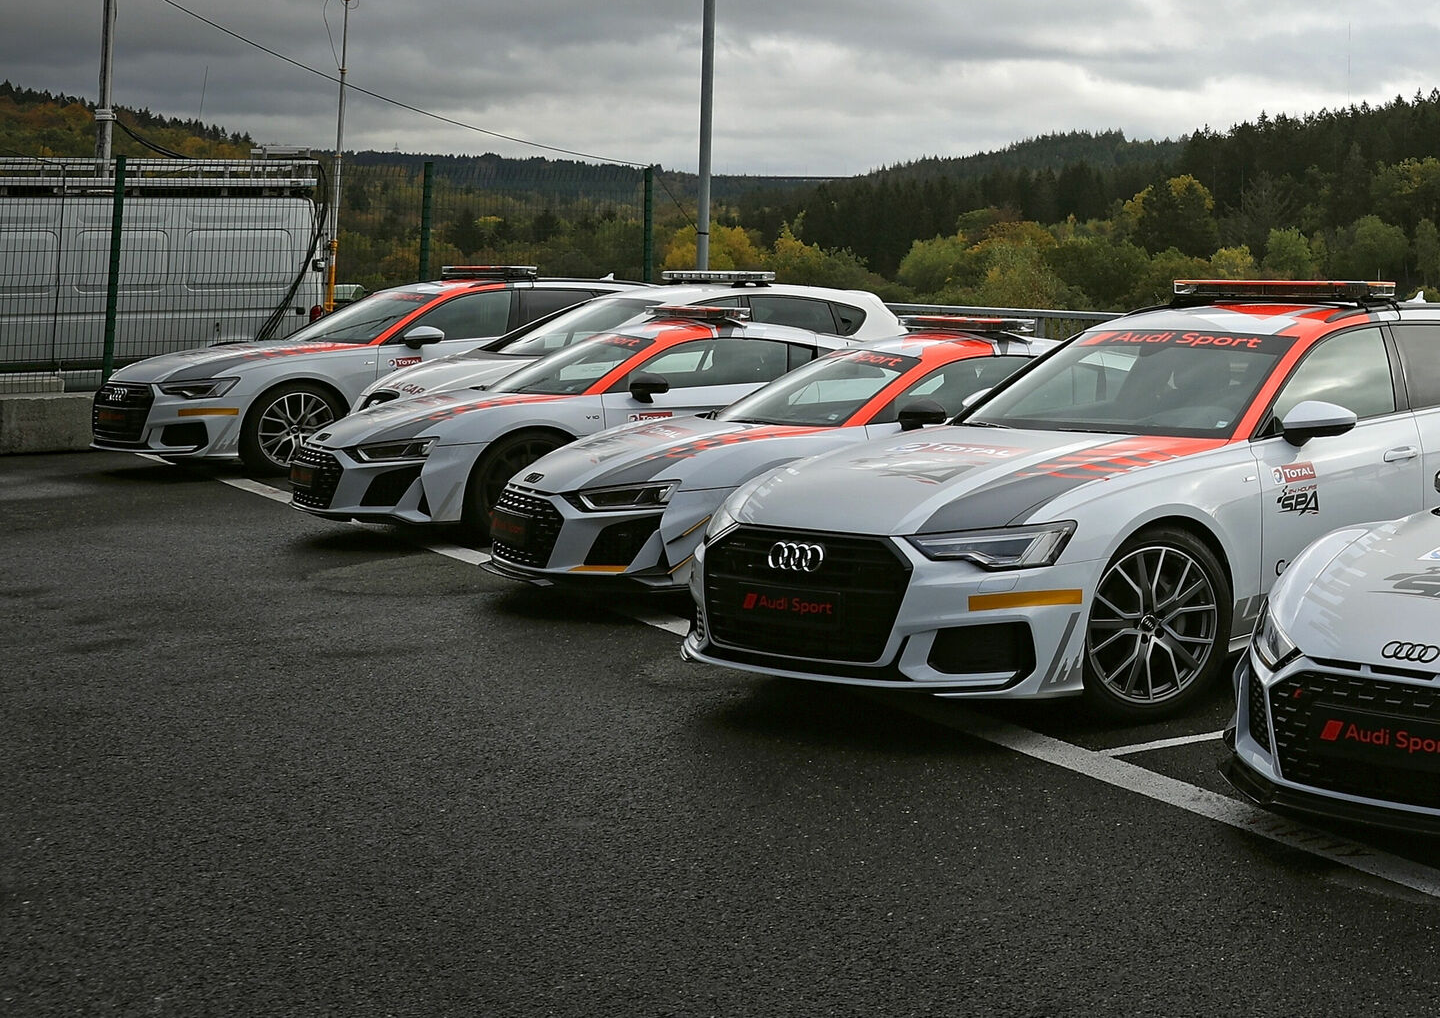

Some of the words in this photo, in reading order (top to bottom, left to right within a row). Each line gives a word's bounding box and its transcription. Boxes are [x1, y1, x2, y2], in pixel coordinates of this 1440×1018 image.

[1111, 331, 1176, 344] Audi
[1176, 332, 1263, 349] Sport
[932, 444, 1013, 457] TOTAL
[1284, 467, 1314, 478] TOTAL
[1277, 491, 1320, 516] SPA
[758, 595, 788, 610] Audi
[791, 597, 833, 615] Sport
[1344, 723, 1390, 746] Audi
